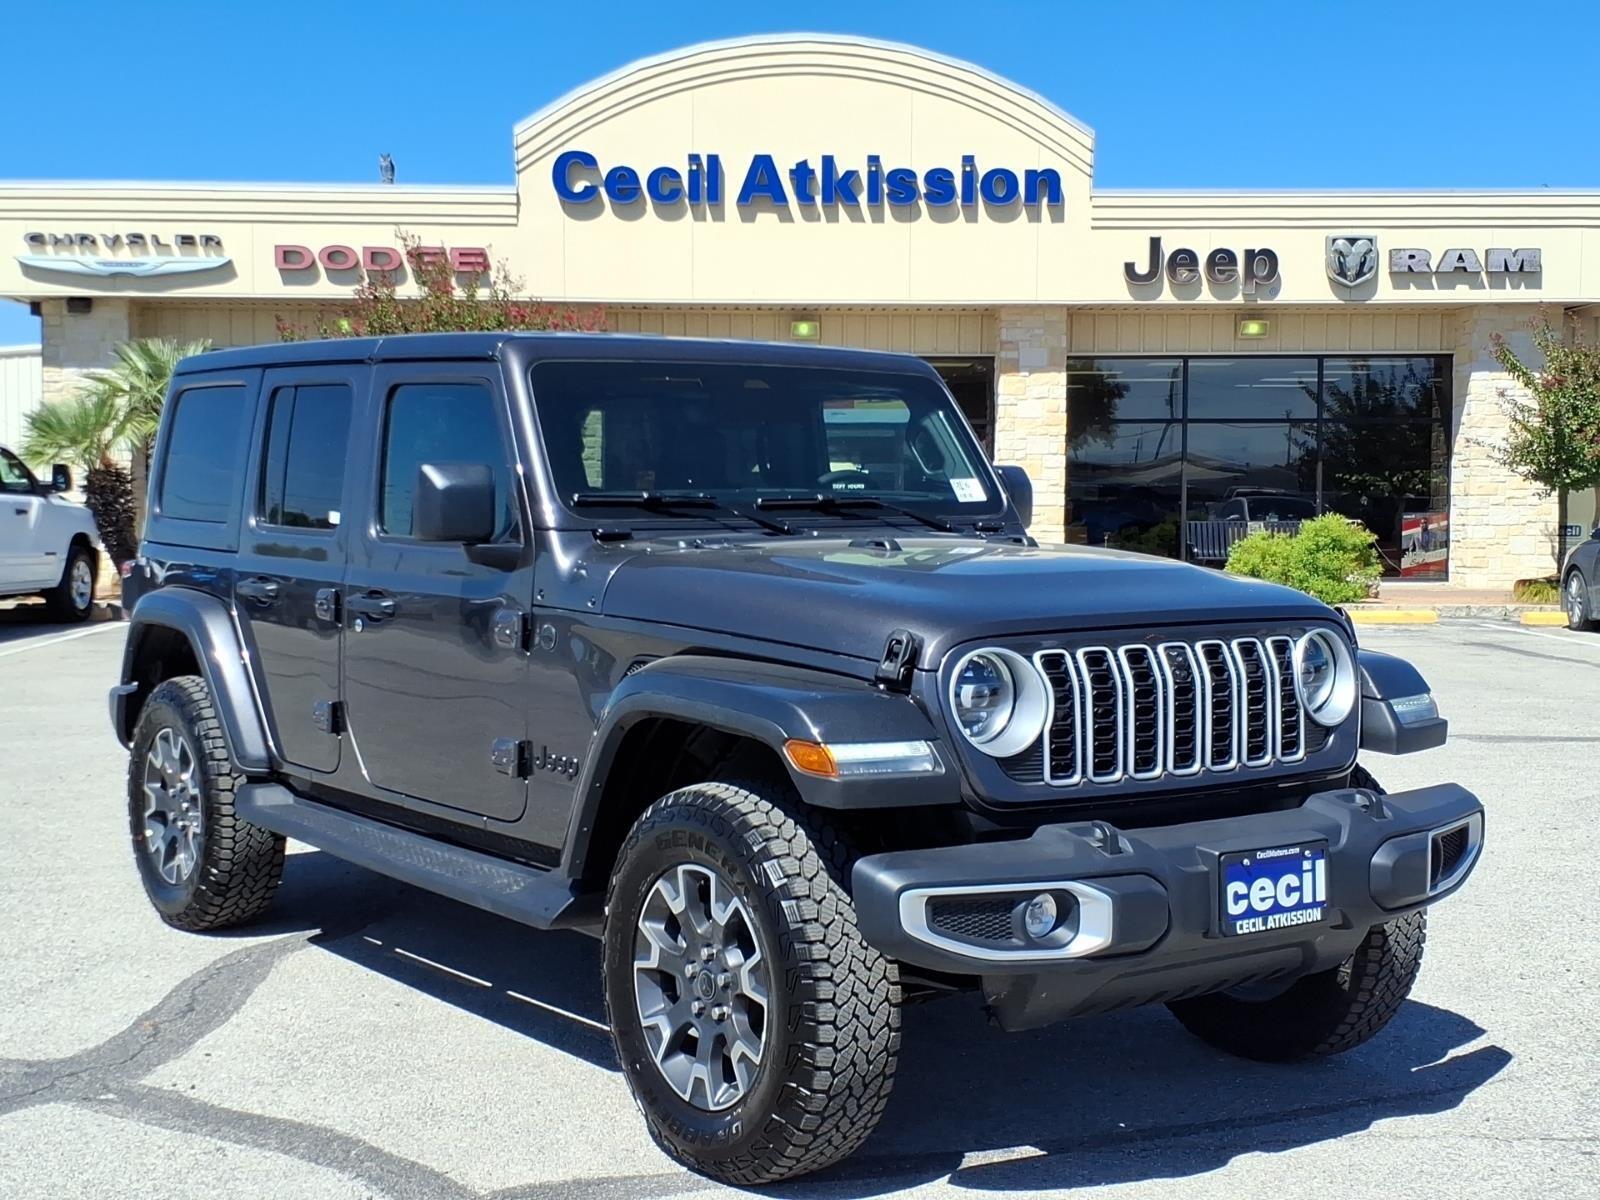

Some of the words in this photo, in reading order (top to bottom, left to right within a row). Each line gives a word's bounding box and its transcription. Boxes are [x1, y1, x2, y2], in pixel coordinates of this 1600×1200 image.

[551, 150, 720, 205] Cecil
[737, 154, 1062, 206] Atkission
[24, 232, 224, 247] CHRYSLER
[274, 244, 492, 272] DODGE
[1124, 236, 1279, 294] Jeep
[1388, 247, 1542, 272] RAM
[535, 745, 579, 781] Jeep
[1226, 859, 1327, 916] cecil
[1235, 917, 1266, 935] CECIL
[1266, 908, 1322, 930] ATKISSION
